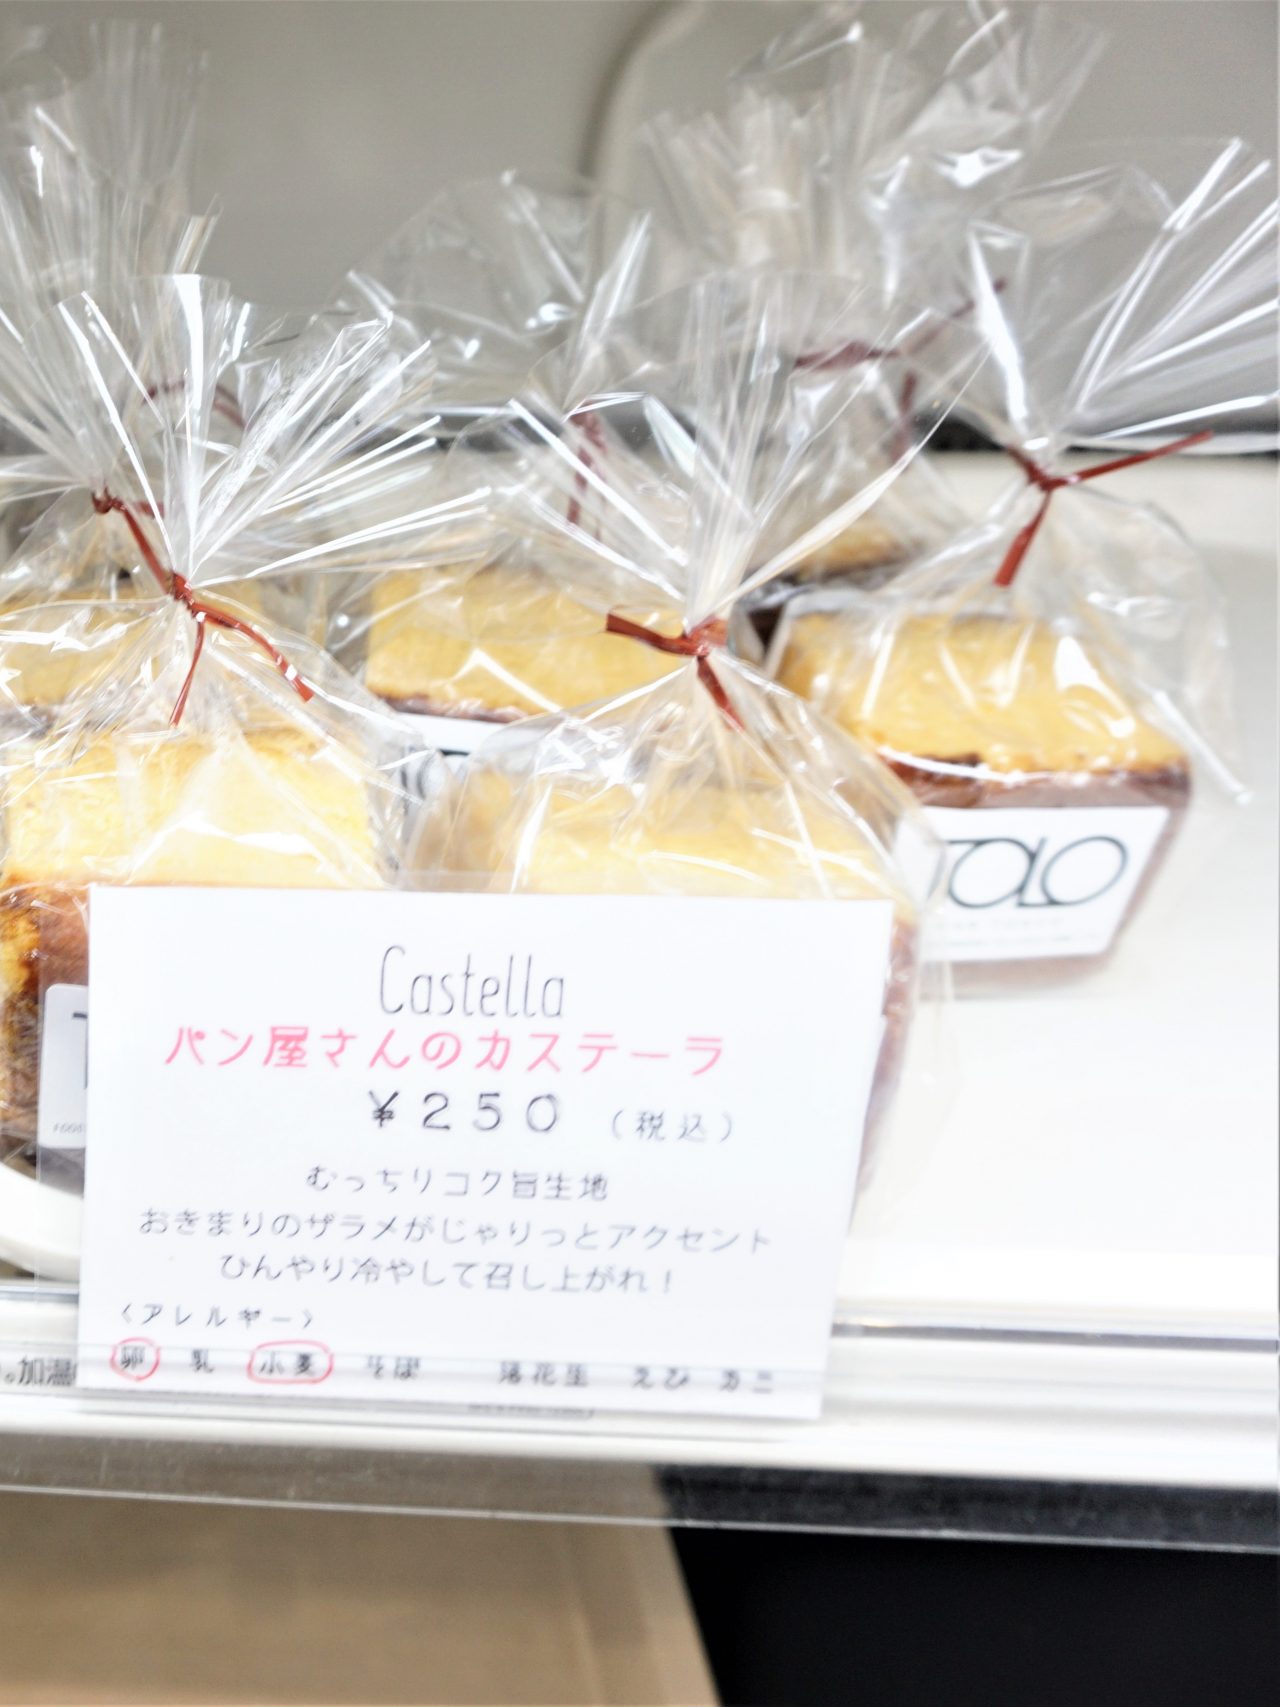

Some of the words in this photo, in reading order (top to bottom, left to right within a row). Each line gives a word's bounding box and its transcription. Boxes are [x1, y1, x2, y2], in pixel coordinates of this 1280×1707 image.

[379, 945, 566, 1019] Castella
[164, 1025, 724, 1077] パン屋さんのカステーラ
[306, 1166, 610, 1202] むっちりコク旨生地
